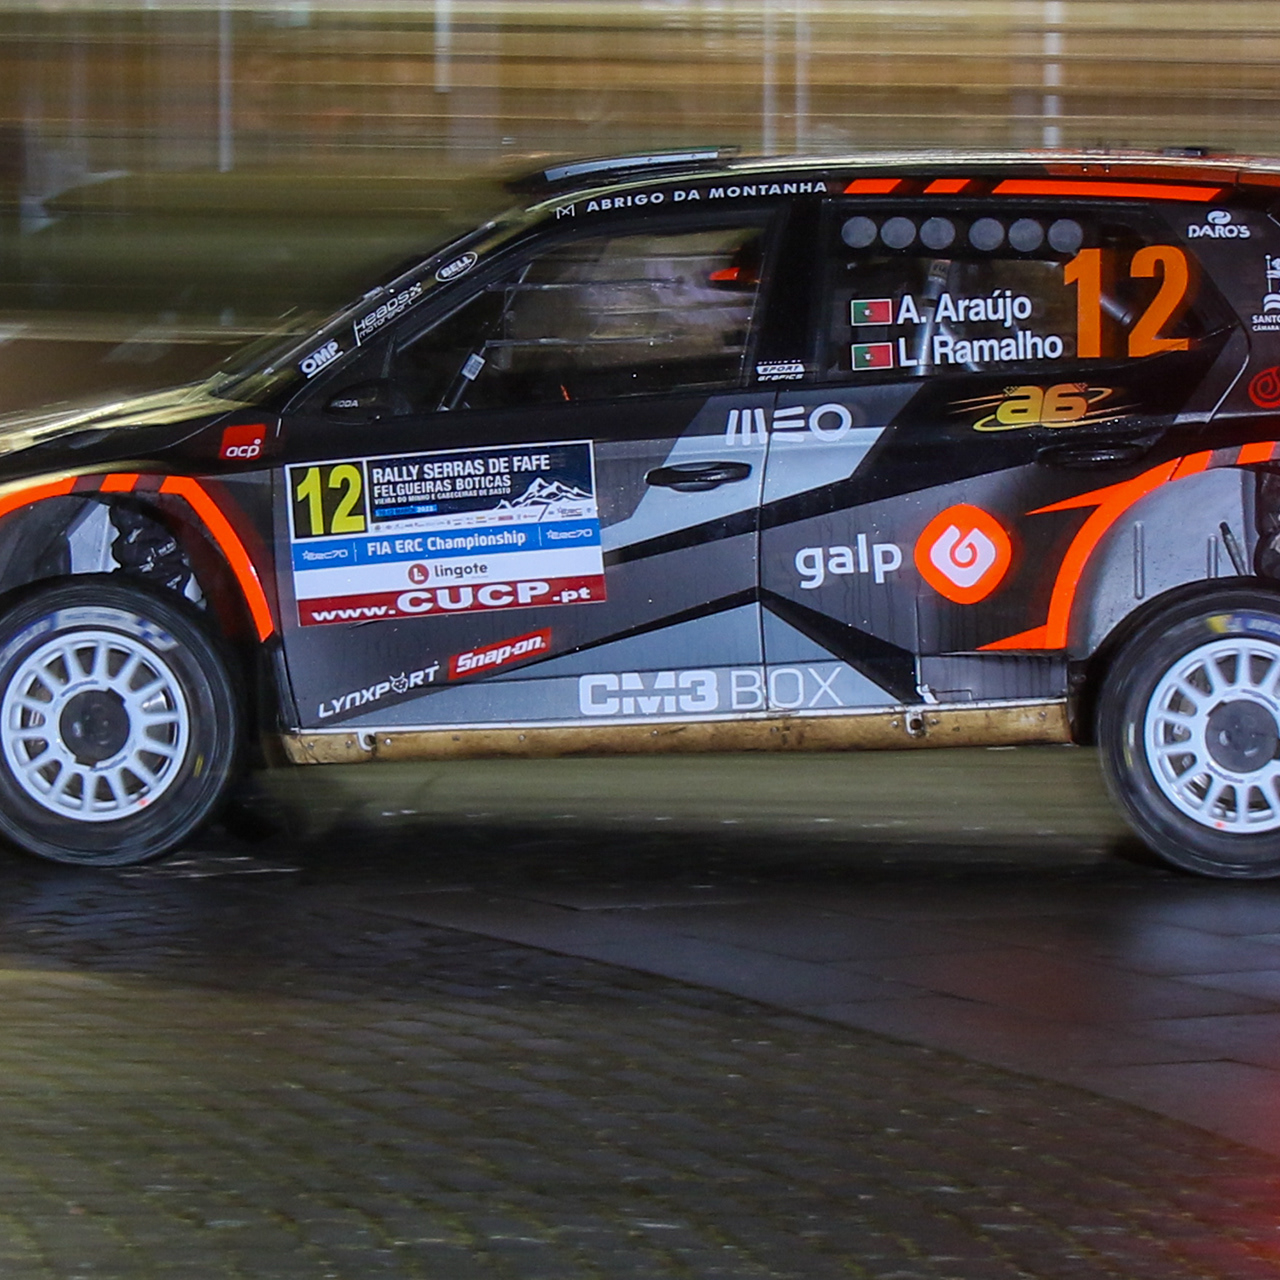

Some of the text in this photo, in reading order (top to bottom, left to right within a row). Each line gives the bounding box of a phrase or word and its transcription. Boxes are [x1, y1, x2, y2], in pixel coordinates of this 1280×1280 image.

[587, 193, 664, 212] ABRIGO
[673, 189, 700, 202] DA
[708, 181, 828, 199] MONTANHA
[441, 256, 473, 278] BELL
[896, 289, 1032, 327] A. Araújo
[1063, 245, 1190, 358] 12
[300, 341, 339, 374] OMP
[898, 330, 1063, 367] L. Ramalho
[762, 365, 800, 373] SPORT
[725, 403, 852, 445] MEO
[226, 445, 260, 458] acp
[372, 454, 551, 484] RALLY SERRAS DE FAFE
[297, 464, 365, 535] 12
[373, 474, 512, 498] FELGUEIRAS BOTICAS
[397, 494, 408, 503] DO
[367, 530, 526, 556] FIA ERC Championship
[434, 562, 488, 579] lingote
[794, 533, 902, 589] galp
[456, 636, 541, 673] Snap-on
[578, 667, 843, 716] CM3 BOX
